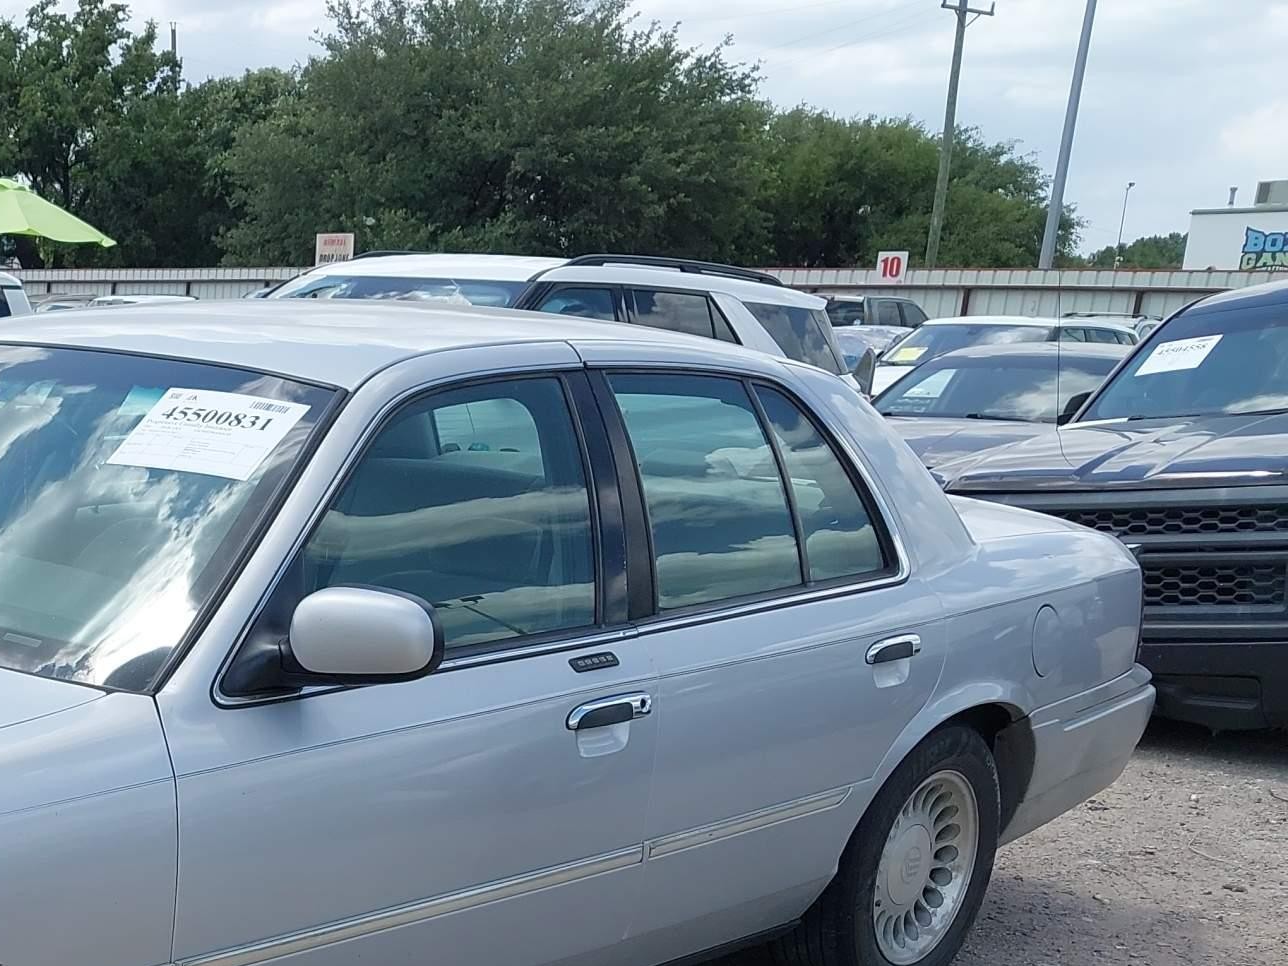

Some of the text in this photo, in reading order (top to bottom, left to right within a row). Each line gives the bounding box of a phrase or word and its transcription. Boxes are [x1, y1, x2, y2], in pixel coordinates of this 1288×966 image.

[1242, 226, 1288, 254] BO
[881, 256, 902, 278] 10
[161, 405, 273, 431] 45500831
